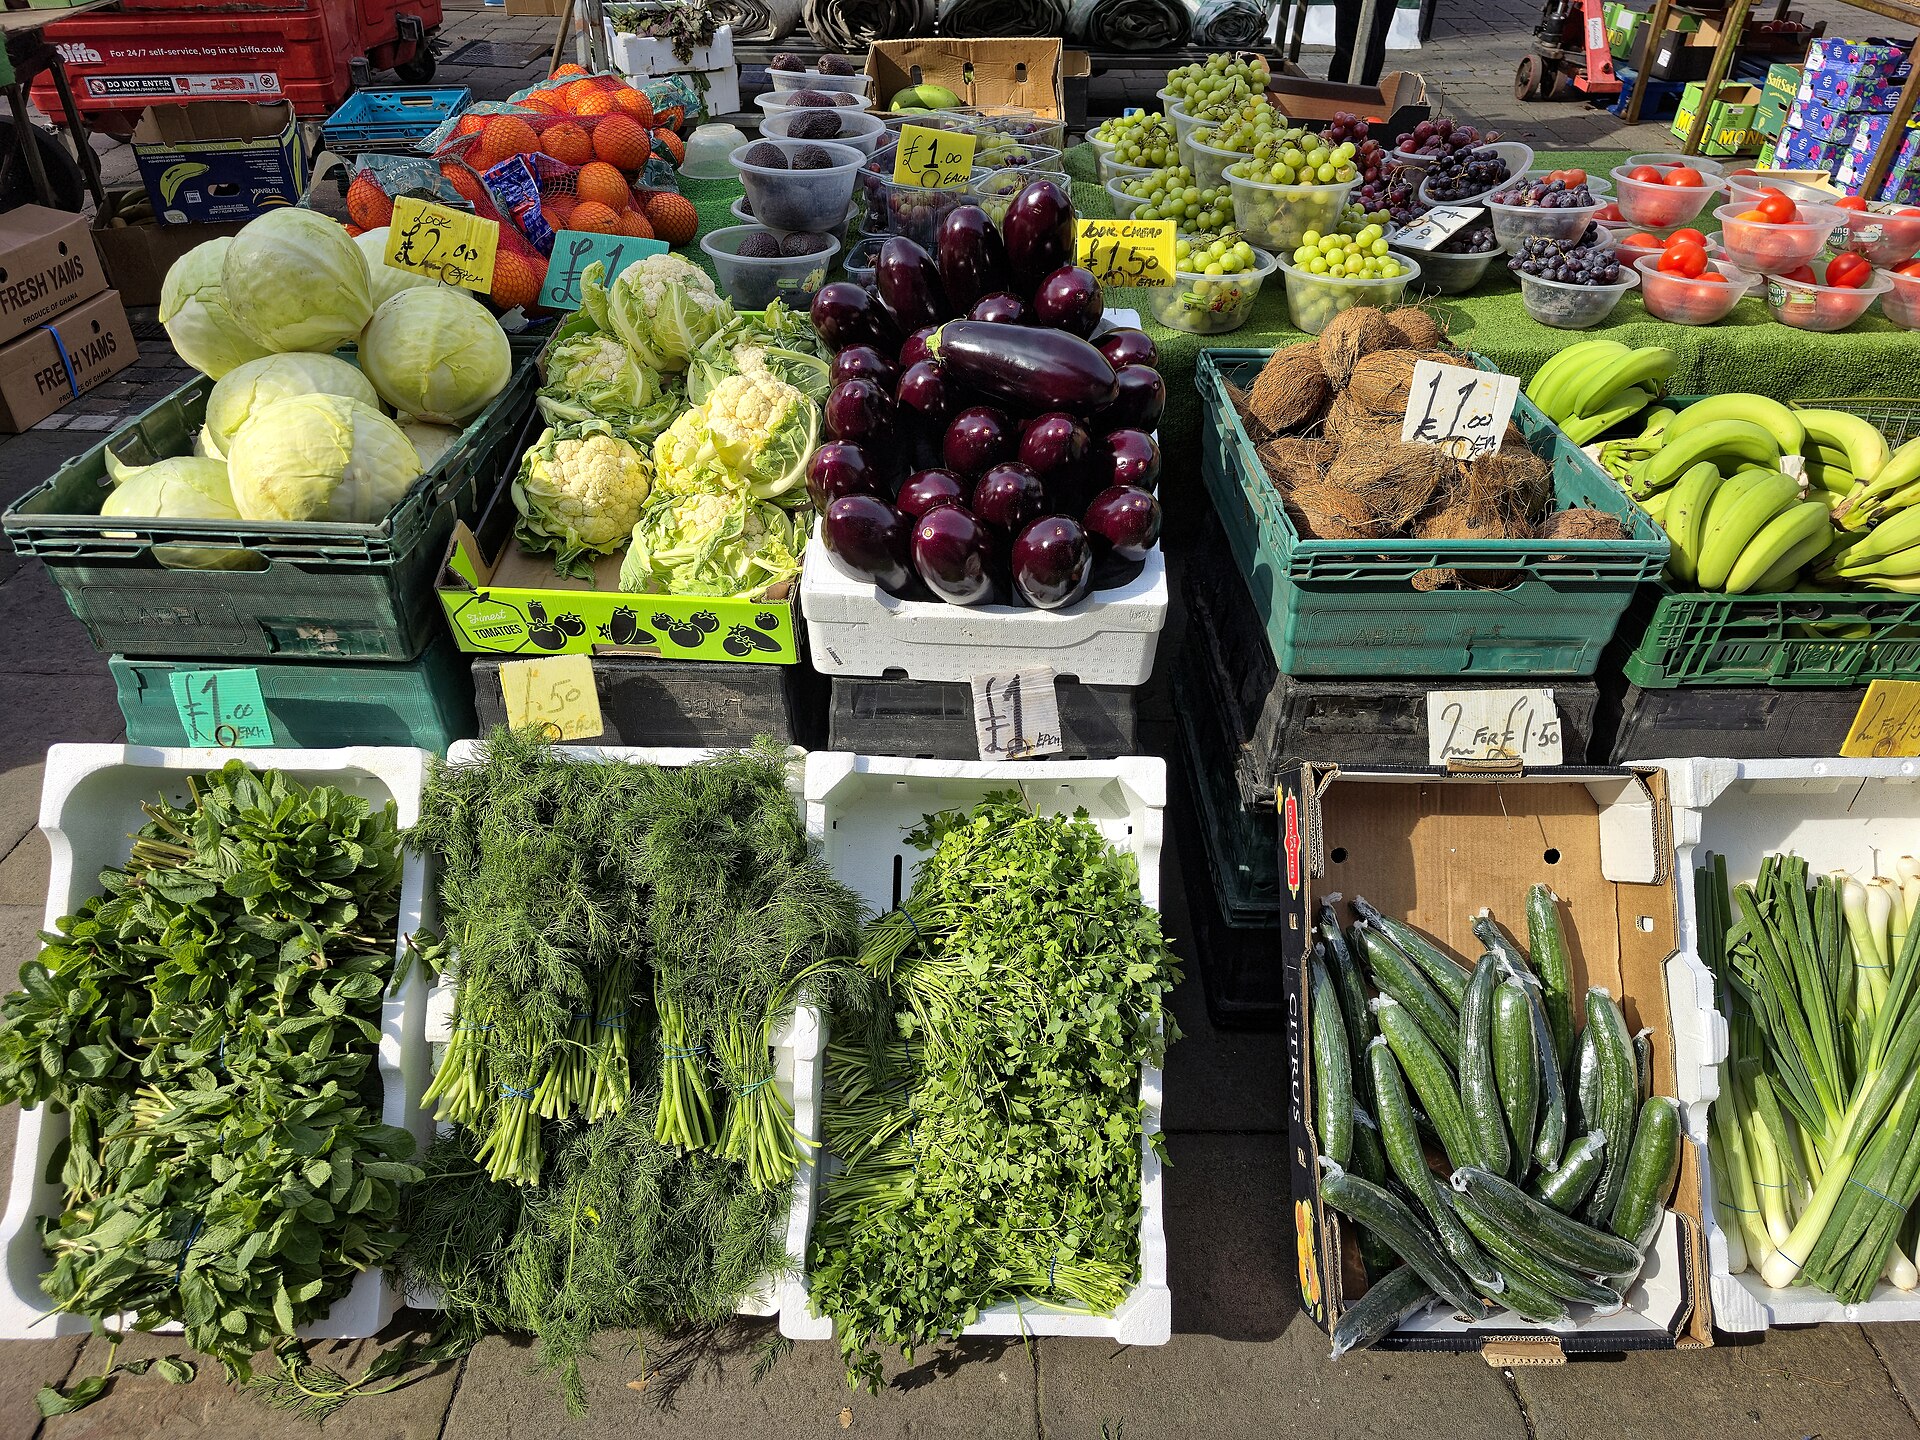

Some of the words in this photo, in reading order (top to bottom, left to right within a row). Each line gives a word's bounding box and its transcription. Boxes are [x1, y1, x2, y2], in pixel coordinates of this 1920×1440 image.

[126, 49, 146, 58] 24/7
[149, 46, 201, 57] self-service,
[202, 46, 217, 55] log
[218, 46, 227, 54] in
[229, 46, 238, 54] at
[240, 45, 284, 54] biffa.co.uk
[122, 80, 140, 88] NOT
[142, 79, 171, 87] ENTER
[902, 135, 962, 173] £1.00
[943, 172, 970, 184] EACH
[394, 225, 479, 268] £2.00
[1121, 225, 1163, 239] CHEAP
[1083, 238, 1159, 281] £1.50
[0, 272, 49, 315] FRESH
[47, 255, 84, 291] YAMS
[1135, 278, 1165, 287] EACH
[22, 306, 50, 325] PRODUCE
[50, 302, 60, 311] OF
[59, 292, 78, 306] GHANA
[34, 351, 82, 396] FREH
[80, 331, 117, 367] YAMS
[84, 376, 95, 386] OF
[92, 367, 112, 381] GHANA
[466, 610, 507, 625] Finest
[473, 624, 523, 640] TOMATOES
[183, 673, 254, 743] £1.00
[979, 674, 1035, 754] £1
[1440, 703, 1475, 759] 2
[1494, 696, 1560, 759] £1.50
[1287, 805, 1295, 880] DOMAINES
[1289, 992, 1301, 1123] CITRUS
